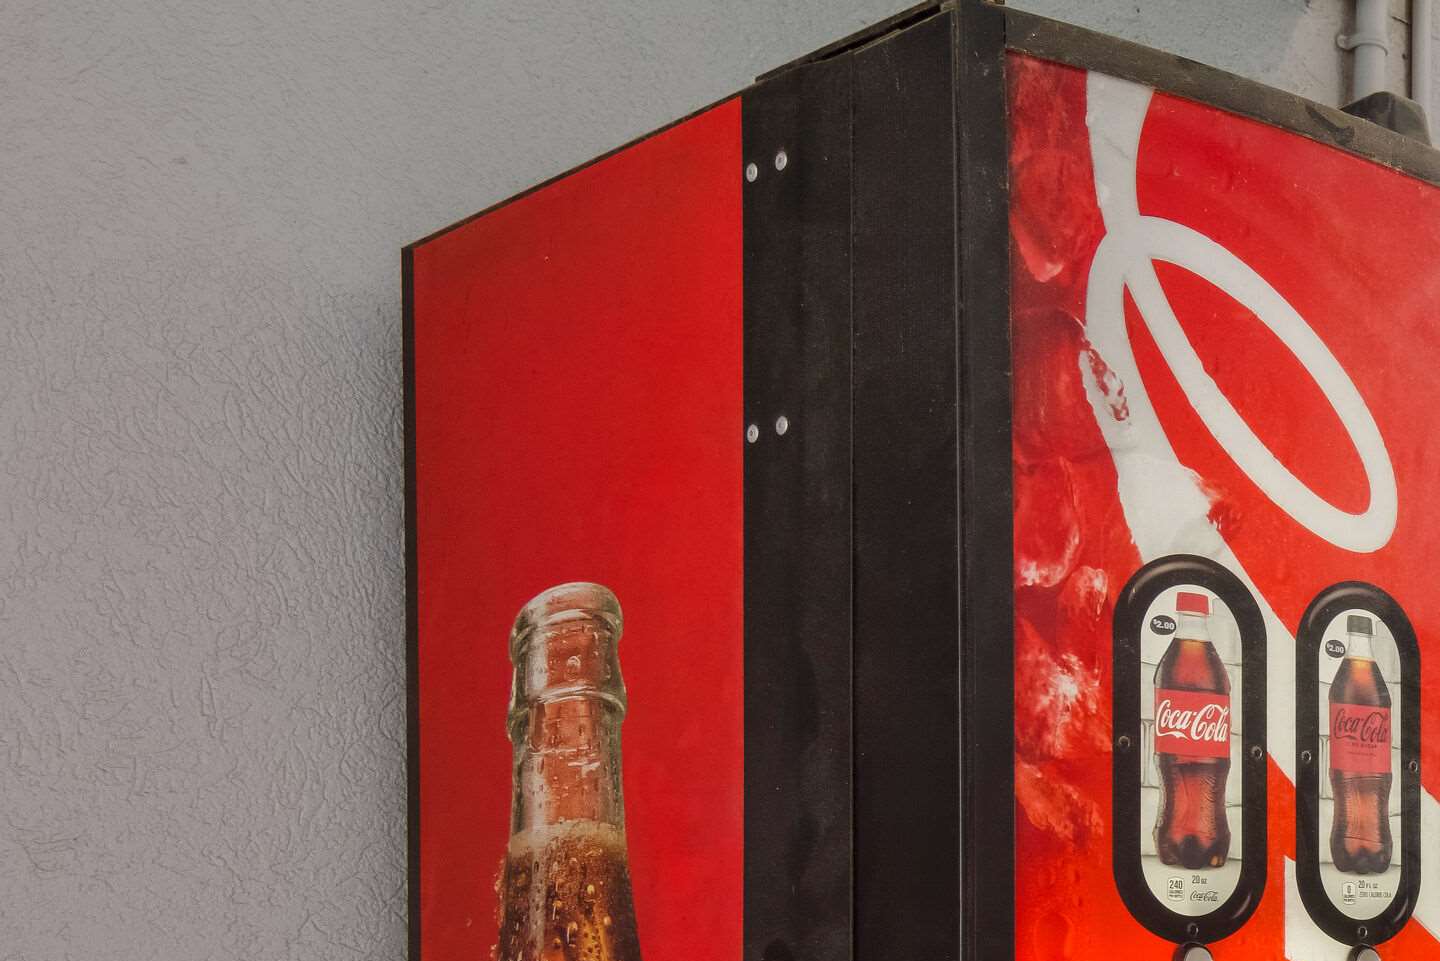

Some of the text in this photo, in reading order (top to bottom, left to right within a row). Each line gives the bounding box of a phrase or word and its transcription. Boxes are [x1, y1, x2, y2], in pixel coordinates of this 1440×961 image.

[1156, 699, 1229, 742] Coca-Cola
[1334, 708, 1388, 743] Coca-Cola
[1169, 880, 1183, 889] 240
